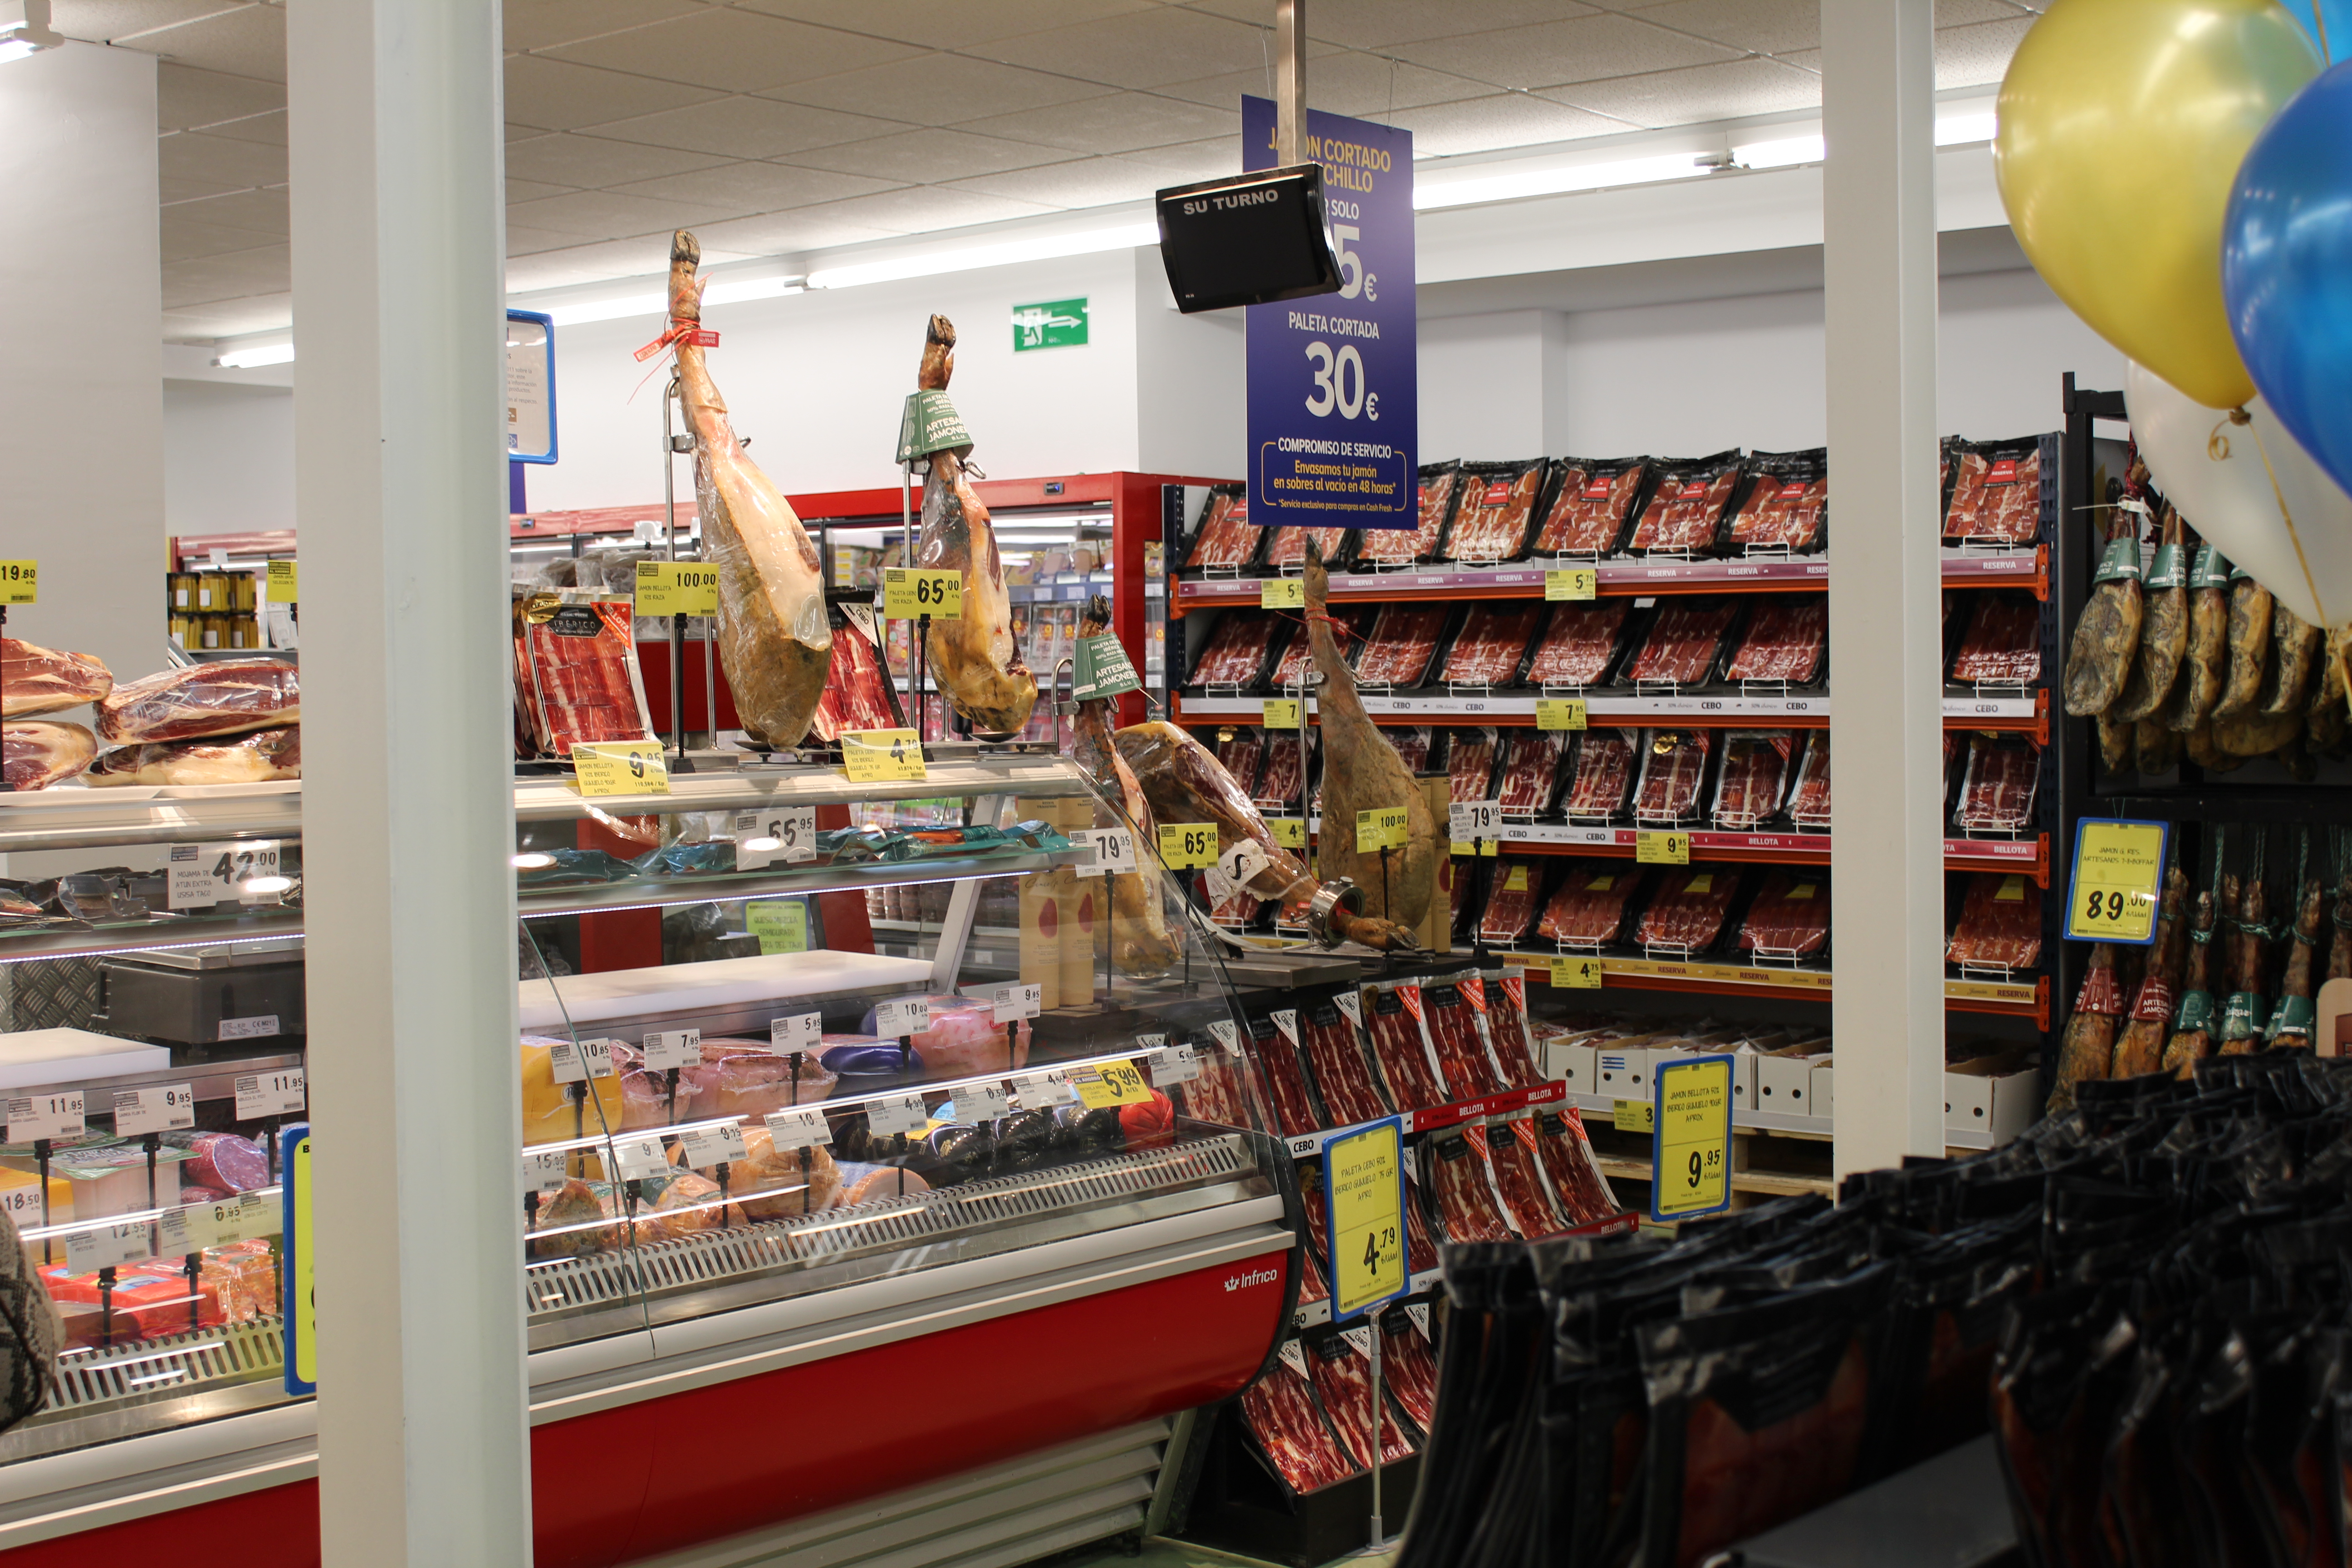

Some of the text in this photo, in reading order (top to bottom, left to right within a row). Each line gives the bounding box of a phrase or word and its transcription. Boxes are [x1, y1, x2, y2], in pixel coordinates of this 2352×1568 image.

[1324, 138, 1391, 173] CORTADO
[1323, 162, 1373, 193] CHILLO
[1184, 189, 1279, 215] SU TURNO
[1331, 199, 1359, 220] SOLO
[1289, 311, 1380, 340] PALETA CORTADA
[922, 394, 942, 405] PALETA
[1278, 437, 1392, 459] COMPROMISO DE SERVICIO
[1295, 460, 1377, 479] Envasamos tu jamón
[1274, 479, 1284, 489] en
[1286, 478, 1313, 490] sobres
[1315, 480, 1324, 491] al
[1325, 479, 1346, 492] vacío
[1348, 483, 1358, 493] en
[1359, 480, 1370, 493] 48
[1301, 500, 1325, 510] exclusivo
[1326, 502, 1337, 512] para
[1338, 503, 1359, 512] compras
[1367, 503, 1378, 512] Cash
[1379, 504, 1392, 513] Fresh
[2, 565, 35, 581] 19.80
[1727, 567, 1759, 576] RESERVA
[1983, 561, 2017, 570] RESERVA
[676, 572, 716, 588] 100.00
[1417, 576, 1444, 585] RESERVA
[1496, 574, 1523, 583] RESERVA
[1575, 573, 1594, 589] 5.75
[1647, 569, 1677, 578] RESERVA
[1216, 583, 1241, 592] RESERVA
[1348, 578, 1374, 588] RESERVA
[917, 578, 960, 605] 65.00
[604, 603, 630, 632] BELLOTA
[856, 609, 869, 625] CEBO
[1091, 640, 1109, 652] PALETA
[1701, 701, 1722, 710] CEBO
[1786, 702, 1808, 710] CEBO
[1975, 704, 1999, 713] CEBO
[1381, 815, 1406, 828] 100.00
[1471, 807, 1499, 828] 79.95
[769, 817, 813, 847] 55.95
[1508, 830, 1527, 838] CEBO
[1586, 833, 1606, 841] CEBO
[1096, 835, 1130, 860] 79.95
[1185, 831, 1216, 855] 65.00
[1748, 838, 1779, 847] BELLOTA
[1994, 845, 2028, 855] BELLOTA
[177, 870, 201, 878] MOJAMA
[212, 851, 277, 885] 42.00
[192, 880, 212, 888] EXTRA
[177, 891, 194, 899] USISA
[2086, 890, 2147, 921] 89.00
[1580, 962, 1599, 978] 4.75
[1657, 966, 1687, 975] RESERVA
[1739, 971, 1769, 981] RESERVA
[1025, 989, 1040, 1000] 9.95
[1463, 980, 1483, 1002] BELLOTA
[1506, 978, 1522, 1000] BELLOTA
[1997, 988, 2030, 998] RESERVA
[1343, 998, 1356, 1011] CEBO
[1402, 986, 1419, 1009] BELLOTA
[805, 1017, 821, 1030] 5.95
[1281, 1015, 1293, 1029] CEBO
[1219, 1026, 1232, 1040] CEBO
[583, 1044, 609, 1058] 10.85
[274, 1076, 303, 1092] 11.95
[166, 1091, 191, 1106] 9.95
[1528, 1088, 1553, 1102] BELLOTA
[1670, 1090, 1686, 1100] JAMON
[1687, 1088, 1710, 1098] BELLOTA
[50, 1097, 83, 1114] 11.95
[1459, 1103, 1485, 1117] BELLOTA
[1667, 1103, 1685, 1113] IBERICO
[1563, 1108, 1582, 1130] BELLOTA
[1686, 1113, 1703, 1123] APROX
[1468, 1127, 1485, 1147] BELLOTA
[1515, 1119, 1535, 1141] BELLOTA
[1293, 1139, 1315, 1154] CEBO
[1341, 1163, 1362, 1179] PALETA
[1362, 1158, 1375, 1171] CEBO
[1687, 1149, 1721, 1189] 9.95
[1334, 1181, 1352, 1196] IBERICO
[1385, 1166, 1394, 1177] GR
[5, 1193, 40, 1211] 18.50
[1357, 1189, 1372, 1203] APRO
[1363, 1226, 1395, 1276] 4.79
[1240, 1269, 1278, 1289] Infrico
[1415, 1309, 1426, 1324] CEBO
[1354, 1333, 1368, 1348] CEBO
[1285, 1346, 1299, 1361] CEBO
